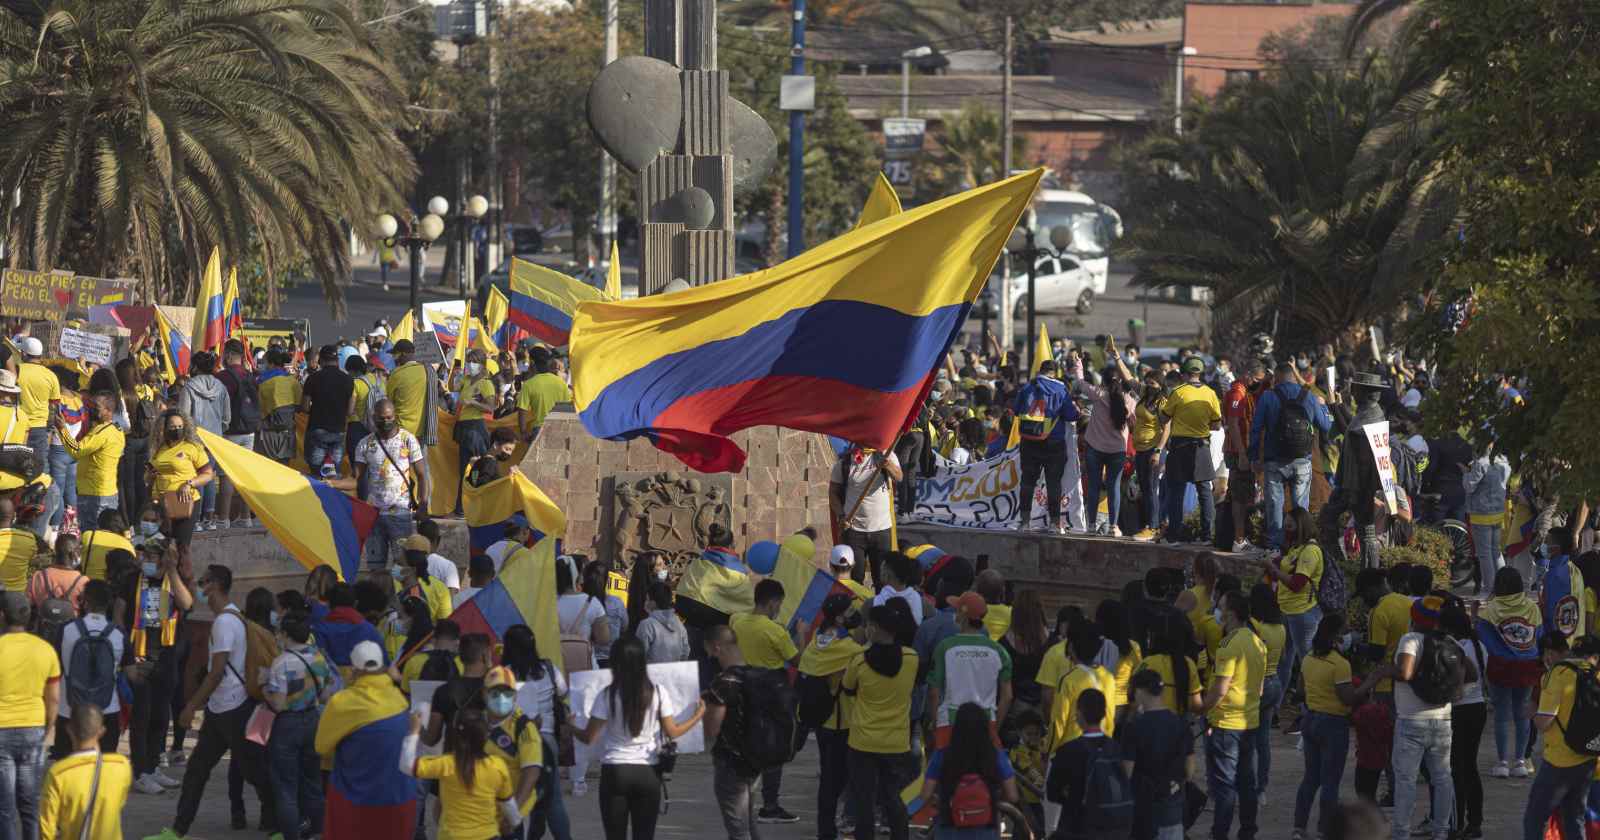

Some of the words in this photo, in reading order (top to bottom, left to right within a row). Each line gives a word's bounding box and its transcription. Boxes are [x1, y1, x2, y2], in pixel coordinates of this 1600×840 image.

[6, 271, 25, 284] CON
[28, 273, 47, 286] LOS
[51, 273, 76, 289] PIES
[5, 283, 34, 300] PERO
[39, 288, 50, 302] EL
